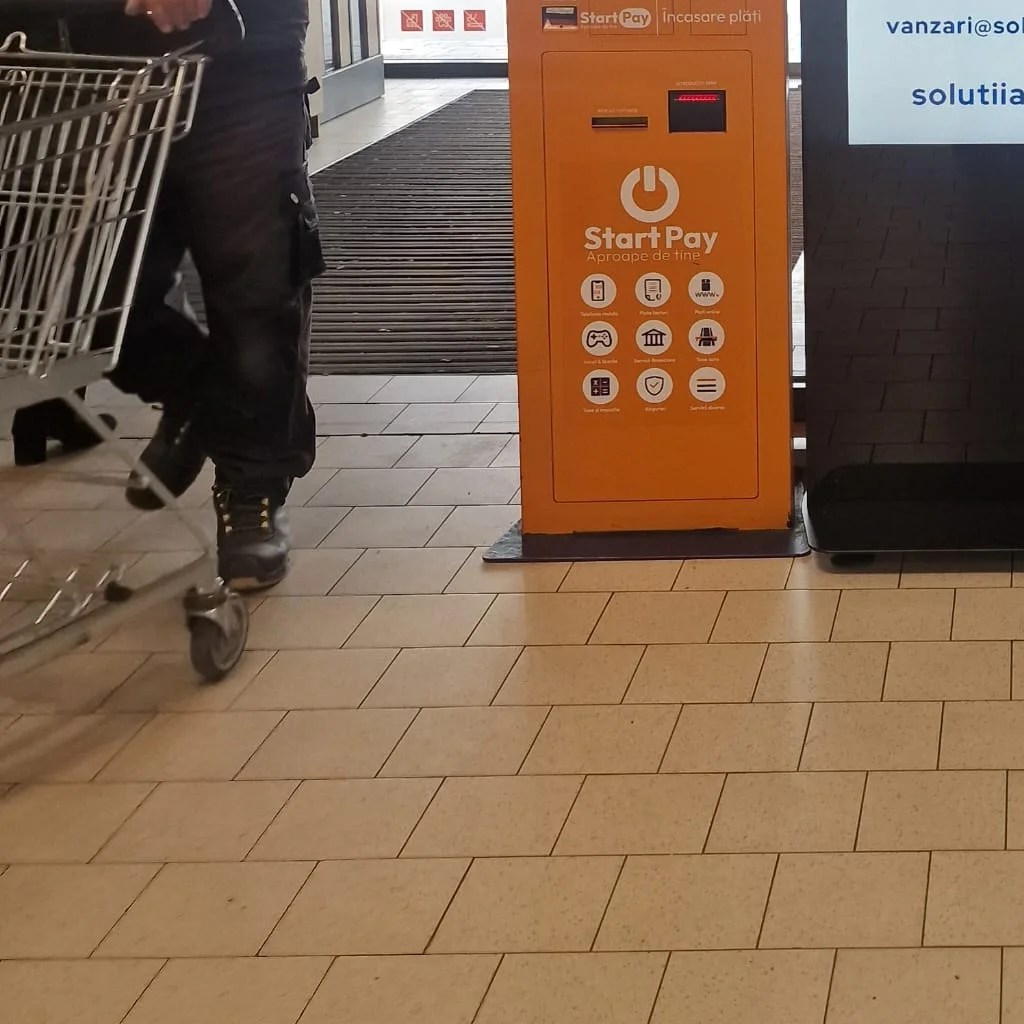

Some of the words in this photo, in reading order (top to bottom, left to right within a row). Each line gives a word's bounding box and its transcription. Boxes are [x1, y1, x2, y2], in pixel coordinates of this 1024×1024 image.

[662, 7, 726, 23] Încasare
[586, 251, 649, 264] Aproape
[652, 250, 671, 261] de
[675, 249, 701, 261] tine
